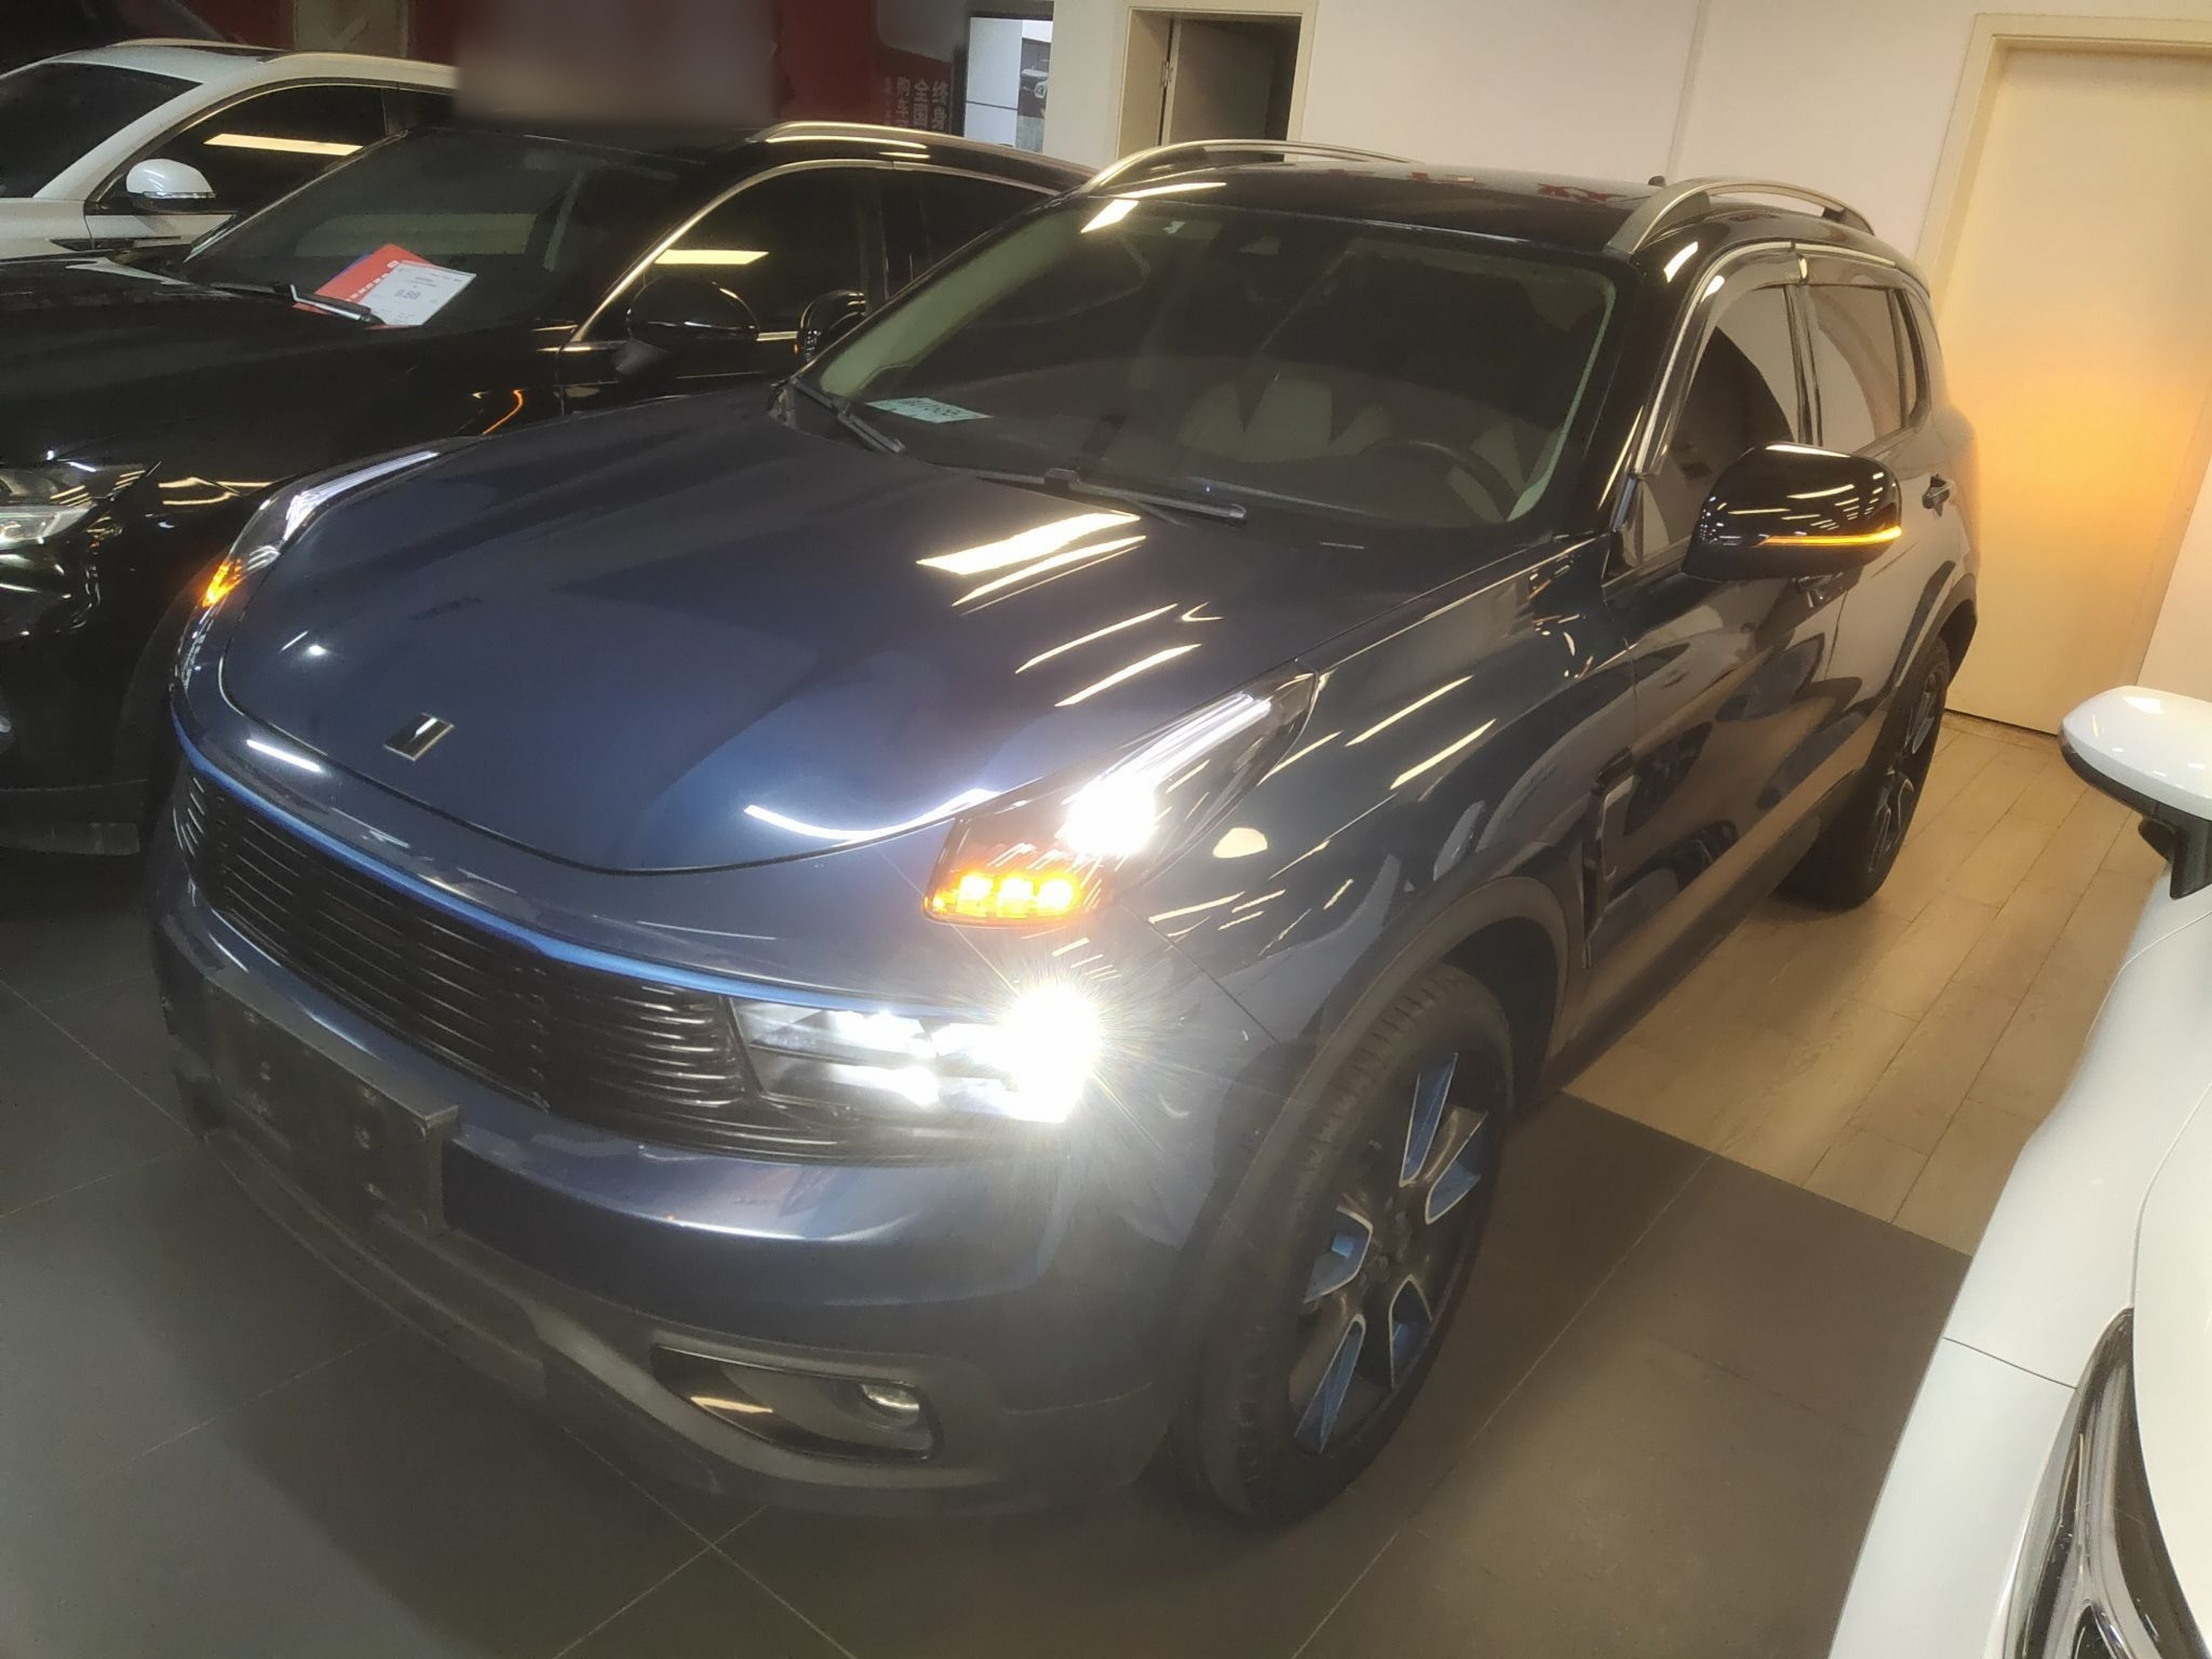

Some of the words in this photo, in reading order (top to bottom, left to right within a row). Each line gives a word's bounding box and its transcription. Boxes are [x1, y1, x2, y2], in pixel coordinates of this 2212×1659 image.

[895, 76, 911, 126] 购车
[913, 78, 929, 127] 全国
[931, 81, 948, 130] 终身
